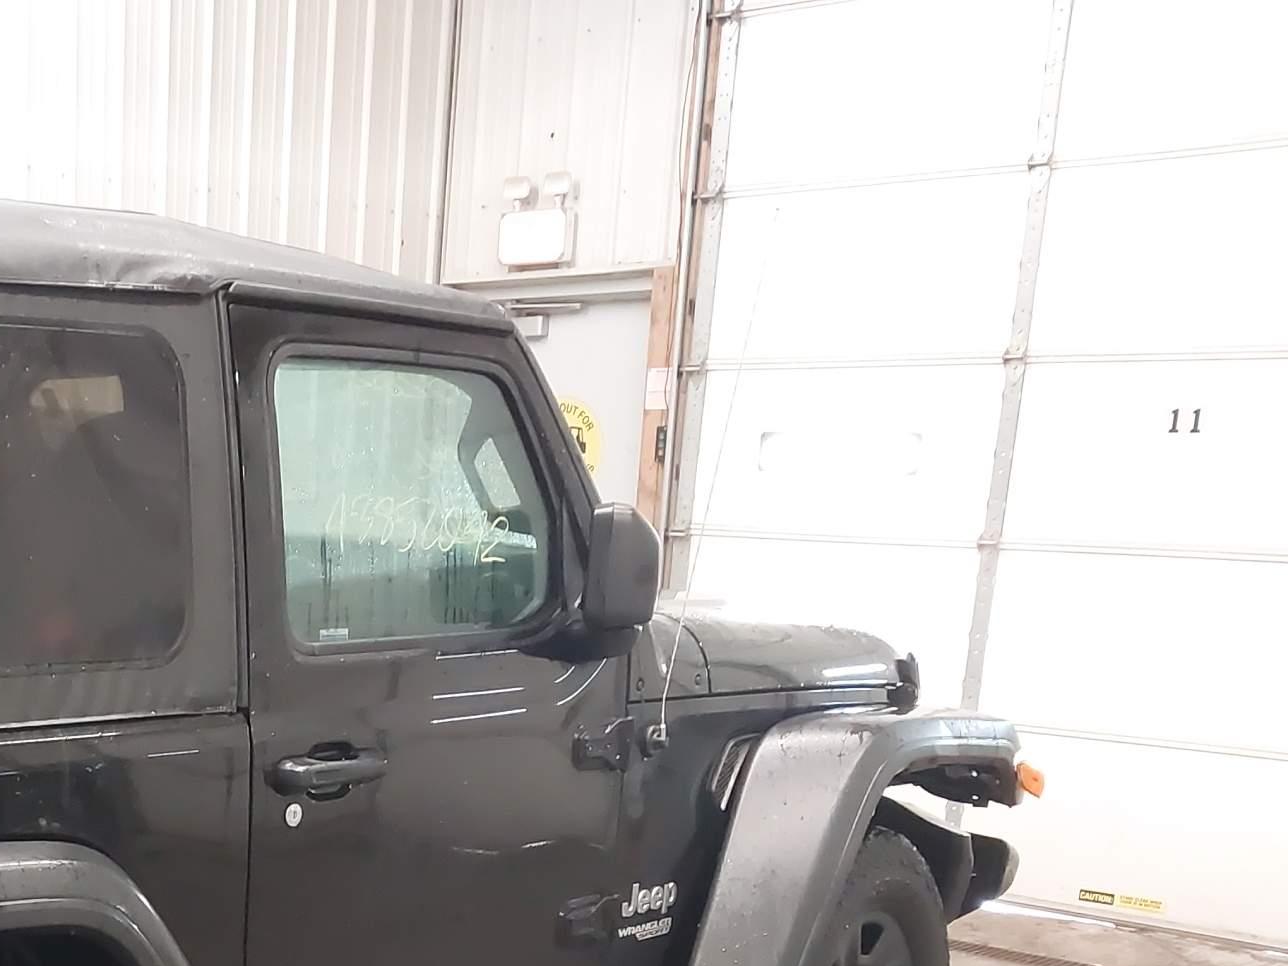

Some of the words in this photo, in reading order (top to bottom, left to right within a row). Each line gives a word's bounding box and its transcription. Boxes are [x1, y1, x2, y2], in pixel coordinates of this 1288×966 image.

[559, 402, 579, 416] OUT
[577, 410, 594, 432] FOR
[1168, 408, 1201, 433] 11
[621, 881, 678, 918] Jeep
[617, 917, 672, 938] WRANGLER
